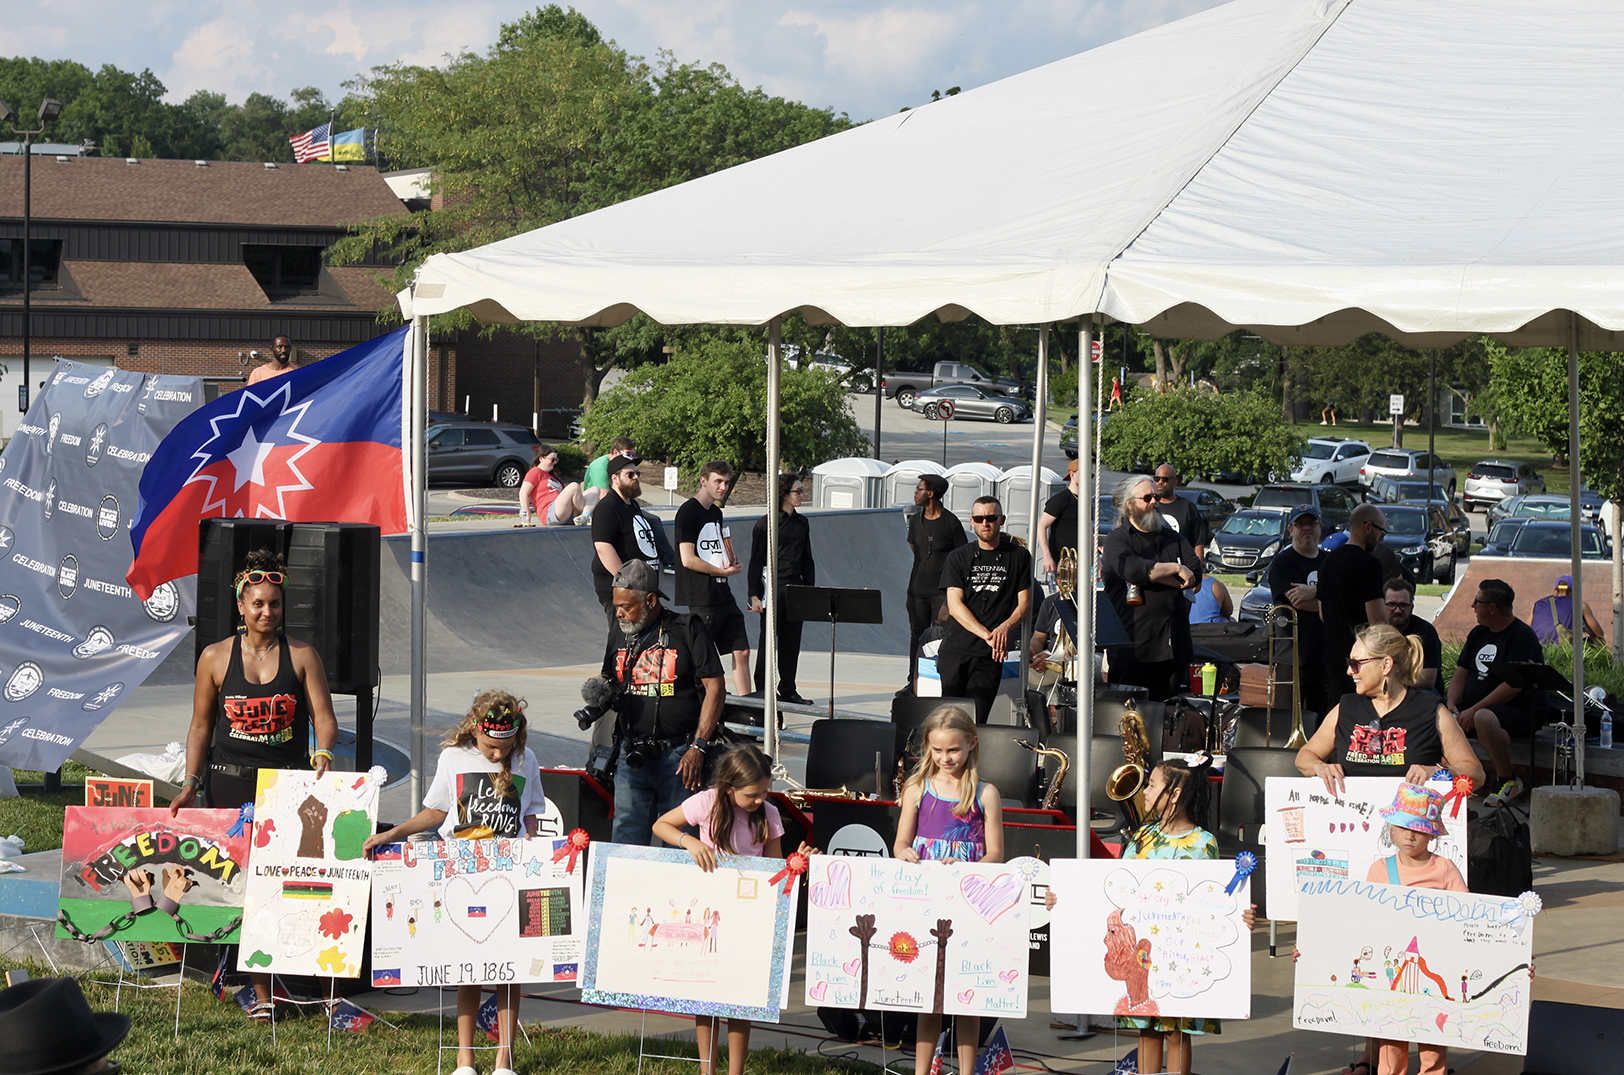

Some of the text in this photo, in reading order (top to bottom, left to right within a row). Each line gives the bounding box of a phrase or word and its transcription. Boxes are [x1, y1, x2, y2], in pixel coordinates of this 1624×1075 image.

[154, 390, 192, 403] CELEBRATION
[17, 423, 47, 436] UNENTH
[60, 433, 81, 447] FREEDOM
[3, 478, 43, 502] FREEDOM
[58, 500, 94, 519] CELEBRATION
[100, 511, 118, 521] BLACK
[12, 553, 56, 577] CELEBRATION
[84, 578, 133, 599] JUNETEENTH
[19, 619, 75, 644] JUNETEENTH
[115, 644, 161, 660] FREEDOM
[46, 687, 85, 700] FREEDOM
[21, 727, 74, 747] CELEBRATION
[467, 793, 518, 824] freedom
[481, 814, 518, 835] RING!
[81, 831, 239, 892] FREEDOM
[434, 856, 513, 881] FREEDOM
[256, 865, 282, 877] LOVE
[289, 865, 318, 878] PEACE
[326, 867, 370, 881] JUNETEENTH
[870, 863, 922, 885] the day
[873, 881, 928, 896] of freedom!
[1137, 910, 1186, 924] JUNETEENTH
[1030, 933, 1048, 942] LEWIS
[1165, 936, 1186, 946] Our
[1162, 949, 1190, 963] History
[417, 961, 516, 986] JUNE 19, 1865
[826, 972, 848, 983] Lives
[976, 975, 997, 985] Lives
[834, 990, 858, 1002] Rock!
[874, 989, 924, 1005] Juneteenth
[985, 994, 1019, 1010] Matter!
